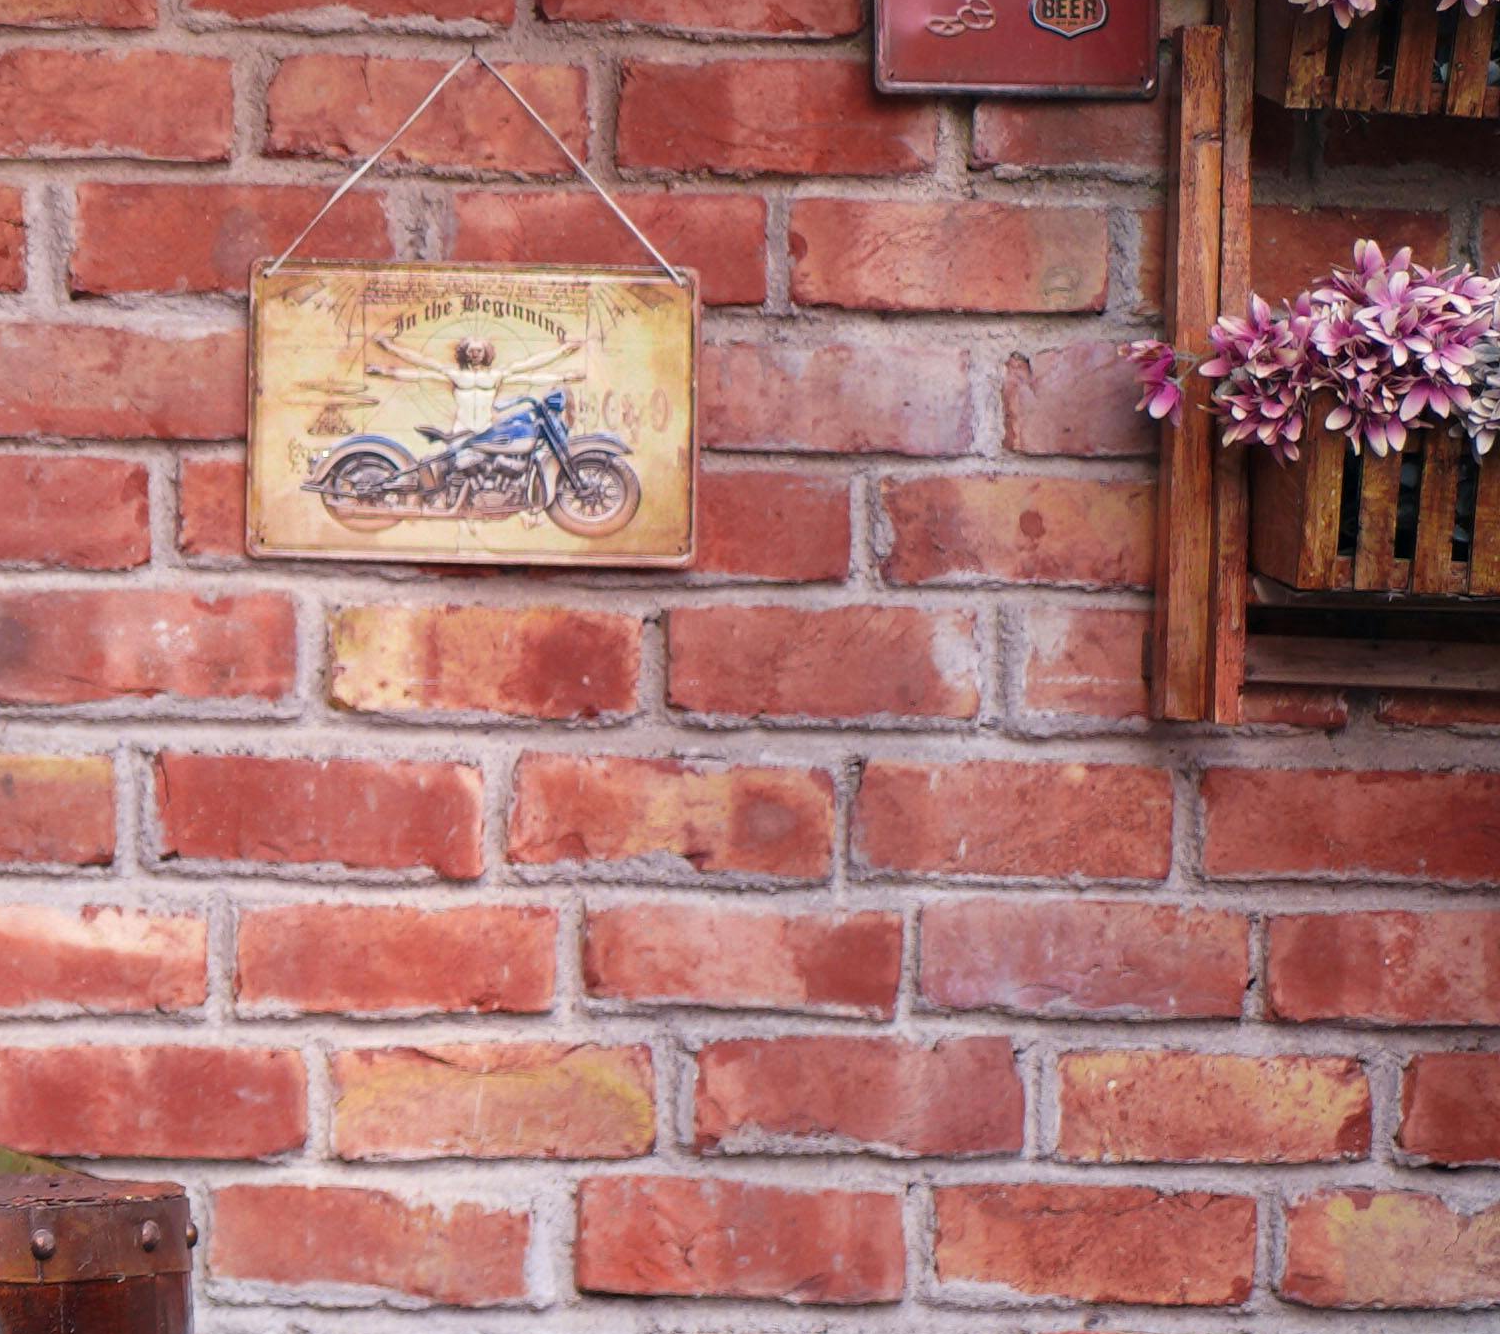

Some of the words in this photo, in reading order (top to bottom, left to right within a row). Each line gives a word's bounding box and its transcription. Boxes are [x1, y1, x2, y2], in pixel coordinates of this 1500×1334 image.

[393, 313, 417, 337] In
[424, 300, 453, 321] the
[460, 293, 567, 344] Beginning
